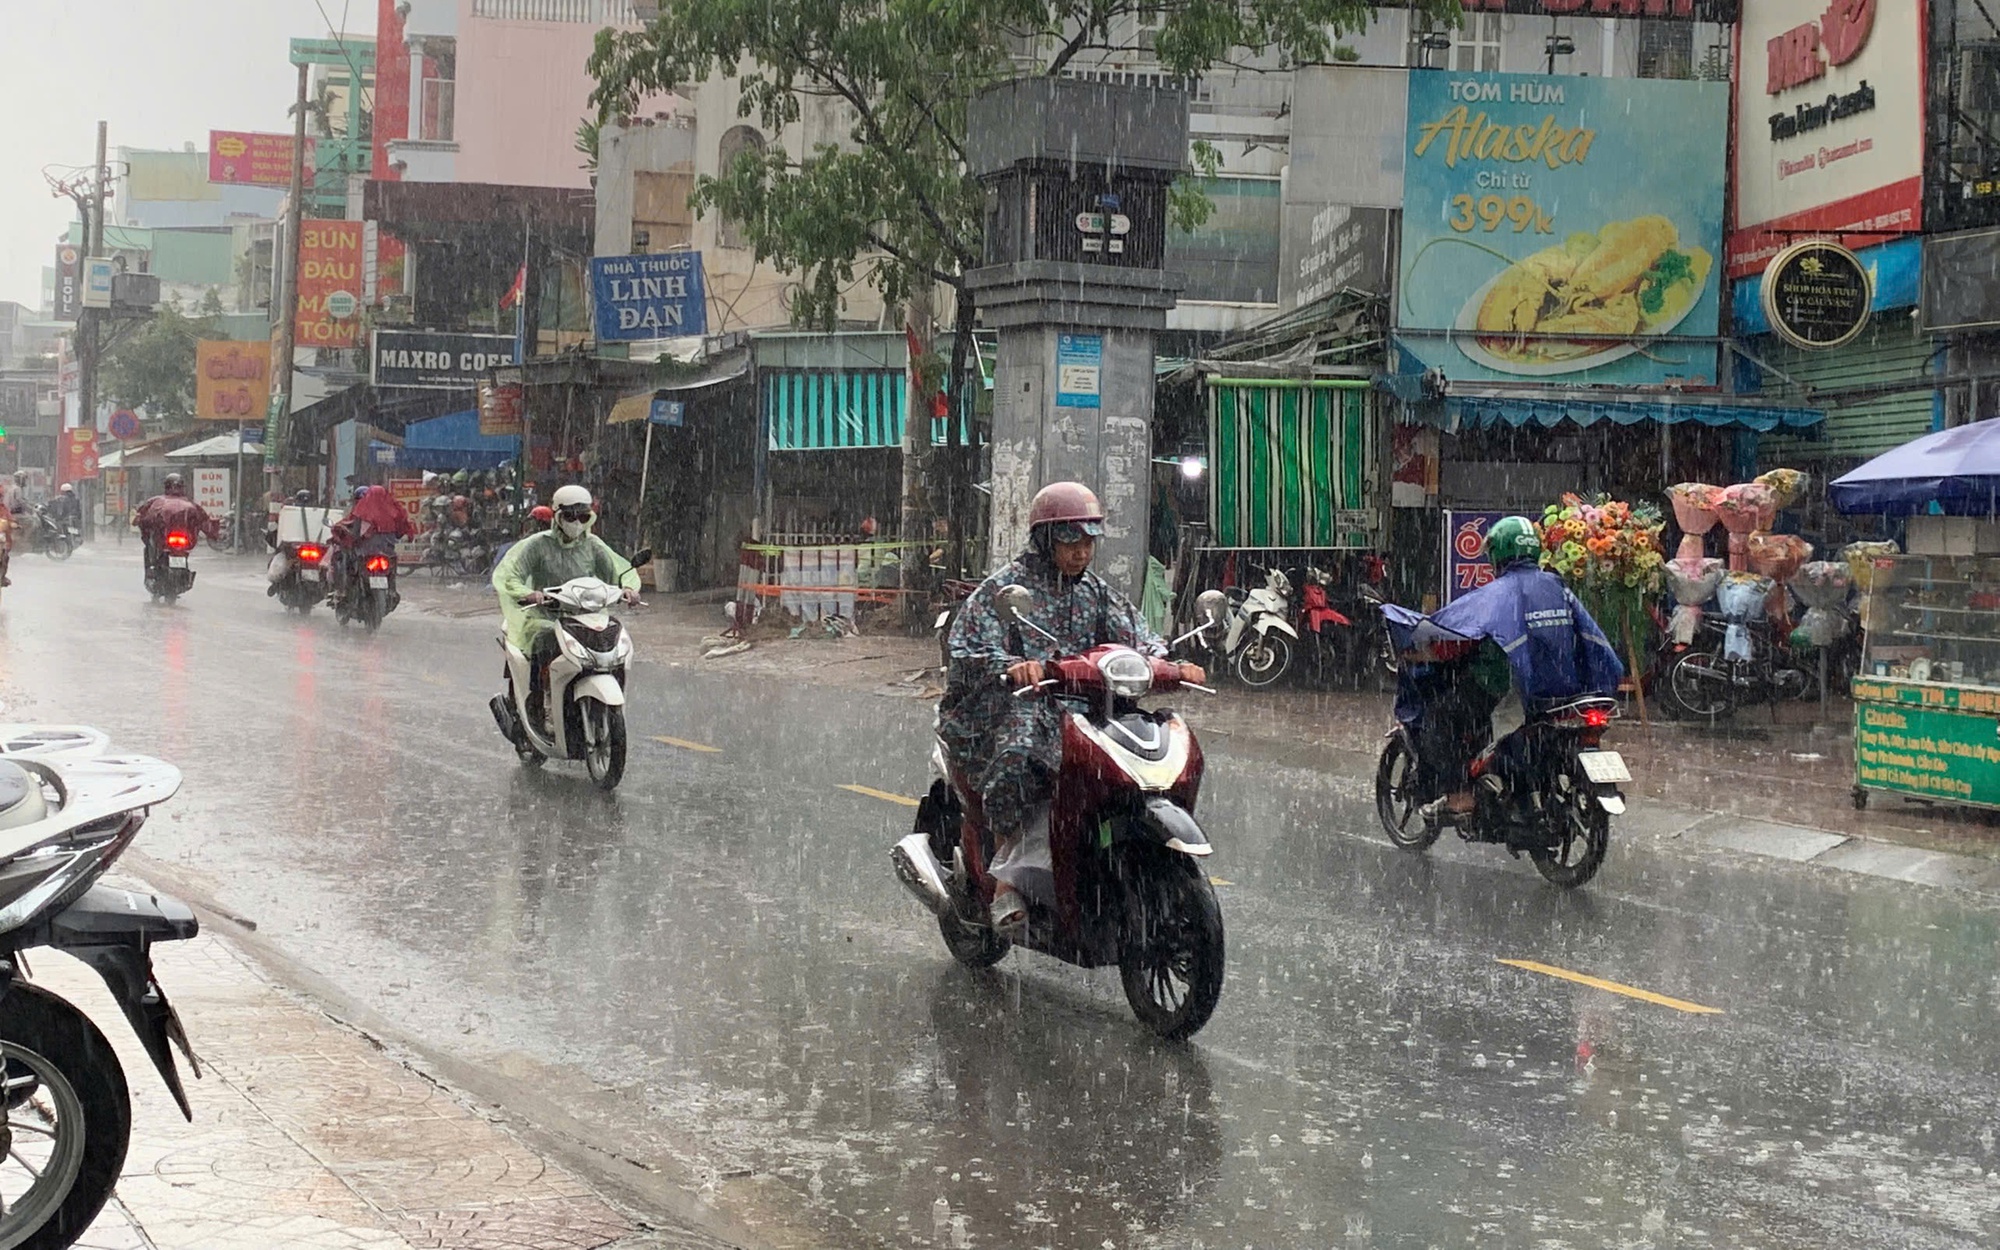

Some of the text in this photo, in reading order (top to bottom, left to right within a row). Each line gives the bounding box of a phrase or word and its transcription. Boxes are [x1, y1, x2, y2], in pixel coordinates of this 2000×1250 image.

[1450, 77, 1565, 104] TÔM HÙM
[1414, 104, 1597, 171] Alaska
[1477, 170, 1532, 188] Chỉ từ
[1450, 194, 1555, 234] 399k
[304, 227, 356, 249] BÚN
[304, 257, 356, 284] ĐẬU
[603, 256, 691, 275] NHÀ THUỐC
[610, 276, 688, 302] LINH
[300, 318, 356, 340] TÔM
[618, 304, 684, 329] ĐAN
[381, 349, 451, 370] MAXRO
[1516, 535, 1540, 547] Grab
[1456, 563, 1495, 588] 75
